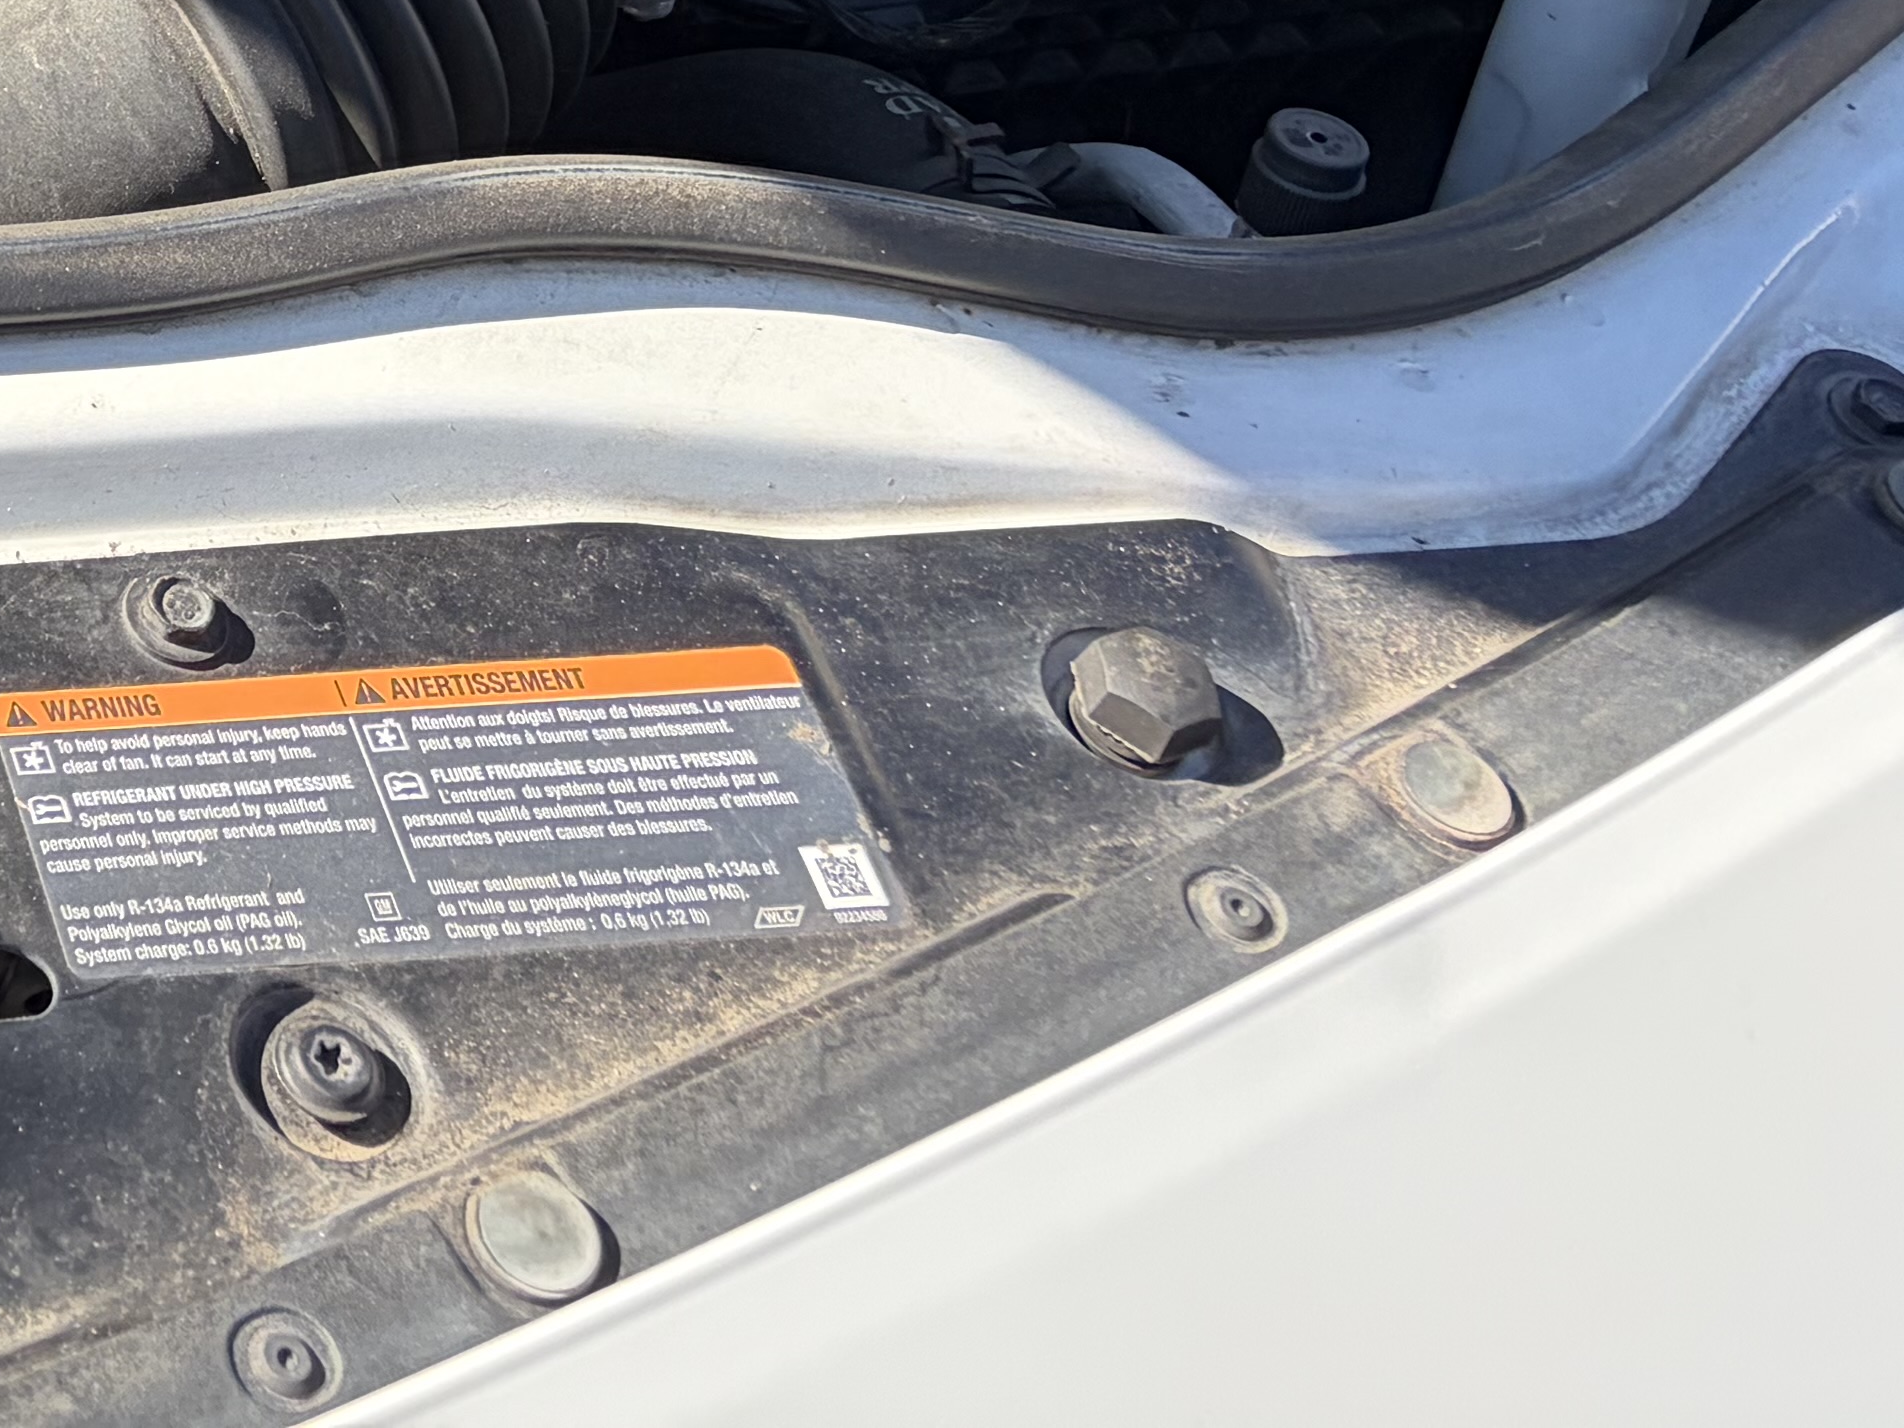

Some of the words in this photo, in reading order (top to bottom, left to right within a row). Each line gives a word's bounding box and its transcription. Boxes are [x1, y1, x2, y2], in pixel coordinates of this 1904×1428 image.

[391, 667, 583, 699] AVERTISSEMENT
[41, 694, 161, 722] WARNING
[411, 713, 476, 731] Attention
[477, 713, 505, 727] aux
[506, 708, 556, 727] doigts!
[556, 706, 607, 723] Risque
[608, 704, 629, 720] de
[628, 702, 703, 718] blessures.
[702, 698, 724, 713] Le
[724, 695, 801, 712] ventilateur
[53, 738, 74, 754] To
[74, 736, 108, 754] help
[110, 733, 150, 750] avoid
[152, 729, 215, 750] personal
[216, 728, 263, 745] injury,
[262, 725, 300, 741] keep
[300, 721, 347, 738] hands
[417, 735, 453, 754] peut
[453, 735, 472, 749] se
[474, 731, 523, 748] mettre
[523, 728, 537, 745] à
[535, 729, 589, 744] tourner
[591, 726, 628, 743] sans
[628, 718, 734, 739] avertissement.
[62, 759, 98, 774] clear
[101, 755, 117, 772] of
[118, 755, 149, 771] fan.
[149, 753, 164, 769] It
[164, 753, 193, 768] can
[194, 749, 230, 766] start
[231, 747, 248, 764] at
[249, 748, 277, 764] any
[277, 745, 317, 760] time.
[430, 765, 485, 783] FLUIDE
[485, 758, 585, 780] FRIGORIGÈNE
[585, 756, 629, 774] SOUS
[628, 753, 681, 771] HAUTE
[680, 748, 758, 768] PRESSION
[72, 785, 176, 806] REFRIGERANT
[178, 781, 232, 800] UNDER
[233, 779, 272, 796] HIGH
[273, 773, 354, 793] PRESSURE
[437, 786, 516, 804] L'entretien
[521, 783, 543, 799] du
[543, 781, 605, 800] système
[606, 777, 637, 794] doit
[637, 776, 668, 792] être
[669, 772, 729, 790] effectué
[730, 772, 756, 789] par
[757, 770, 780, 785] un
[78, 812, 135, 829] System
[136, 809, 154, 824] to
[154, 807, 176, 822] be
[178, 802, 241, 821] serviced
[241, 801, 261, 819] by
[263, 797, 328, 817] qualified
[402, 808, 474, 830] personnel
[476, 805, 531, 825] qualifié
[532, 801, 613, 820] seulement.
[613, 799, 645, 815] Des
[645, 795, 719, 812] méthodes
[719, 790, 799, 809] d'entretien
[39, 832, 113, 854] personnel
[115, 830, 151, 848] only.
[151, 827, 218, 845] Improper
[222, 822, 276, 839] service
[278, 817, 343, 835] methods
[344, 817, 377, 834] may
[409, 830, 493, 849] incorrectes
[494, 825, 554, 846] peuvent
[555, 824, 604, 840] causer
[606, 820, 636, 837] des
[635, 818, 713, 835] blessures.
[45, 858, 91, 874] cause
[93, 850, 158, 872] personal
[159, 848, 208, 867] injury.
[426, 878, 479, 896] Utiliser
[482, 872, 561, 892] seulement
[560, 870, 578, 887] le
[578, 868, 622, 886] fluide
[622, 864, 704, 885] frigorigène
[703, 860, 761, 878] R-134a
[761, 858, 781, 876] et
[59, 903, 90, 921] Use
[93, 900, 125, 919] only
[126, 896, 184, 915] R-134a
[184, 890, 270, 911] Refrigerant
[275, 887, 306, 905] and
[436, 900, 457, 917] de
[457, 898, 505, 915] l'huile
[507, 899, 528, 913] au
[529, 888, 663, 914] polyalkylèneglycol
[664, 885, 708, 905] (huile
[707, 882, 750, 902] PAG).
[763, 907, 796, 925] WLC
[67, 922, 162, 943] Polyalkylene
[164, 916, 211, 937] Glycol
[213, 914, 234, 931] oil
[235, 912, 272, 932] (PAG
[273, 910, 303, 929] oil).
[357, 926, 391, 944] SAE
[393, 924, 431, 942] J639
[444, 922, 499, 940] Charge
[500, 919, 523, 936] du
[523, 916, 587, 937] système
[600, 912, 627, 931] 0,6
[626, 912, 650, 931] kg
[649, 908, 689, 929] (1,32
[688, 907, 711, 926] lb)
[74, 947, 132, 966] System
[134, 942, 192, 960] charge:
[192, 938, 219, 955] 0.6
[219, 937, 243, 956] kg
[244, 934, 284, 954] (1.32
[284, 933, 307, 951] lb)
